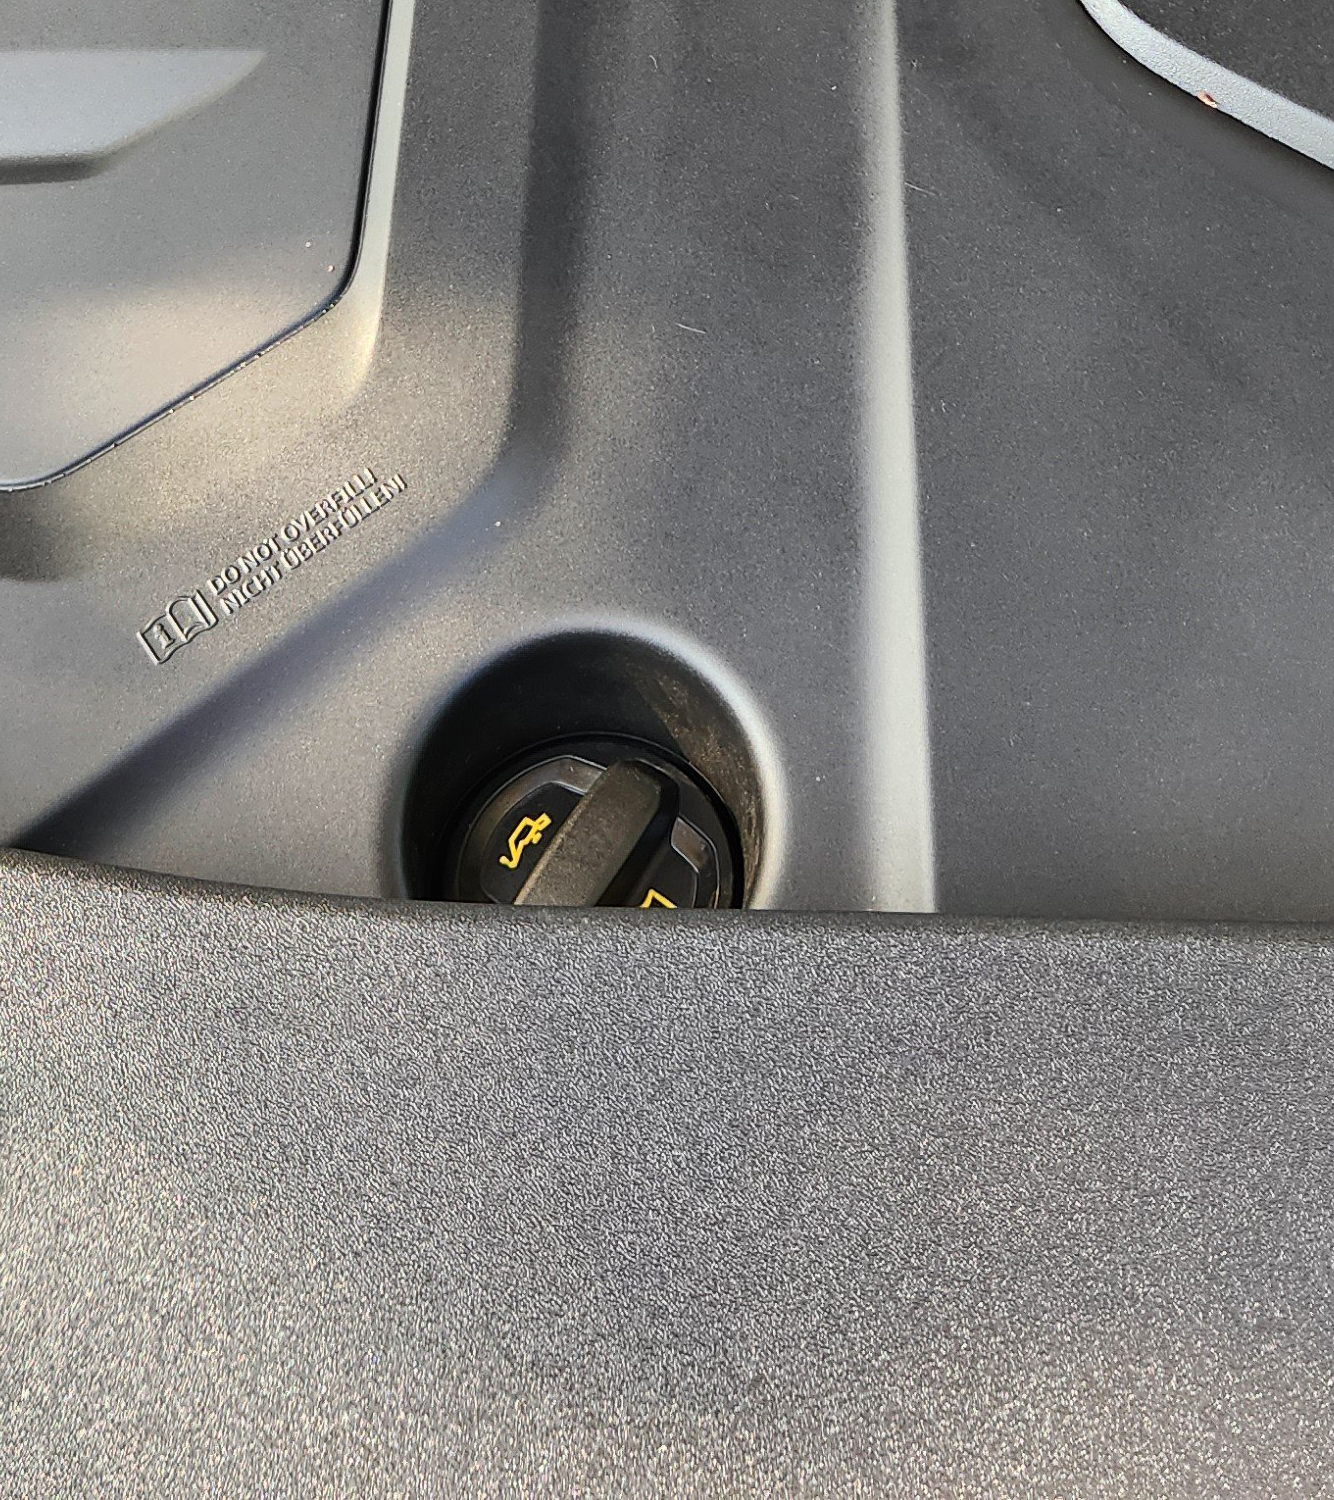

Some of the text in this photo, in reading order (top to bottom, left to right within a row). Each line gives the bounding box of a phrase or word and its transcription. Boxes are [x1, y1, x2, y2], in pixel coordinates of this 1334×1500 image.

[206, 467, 379, 596] DO NOT OVERFILL!
[218, 473, 409, 615] NICHT ÜBERFÜLLEN!
